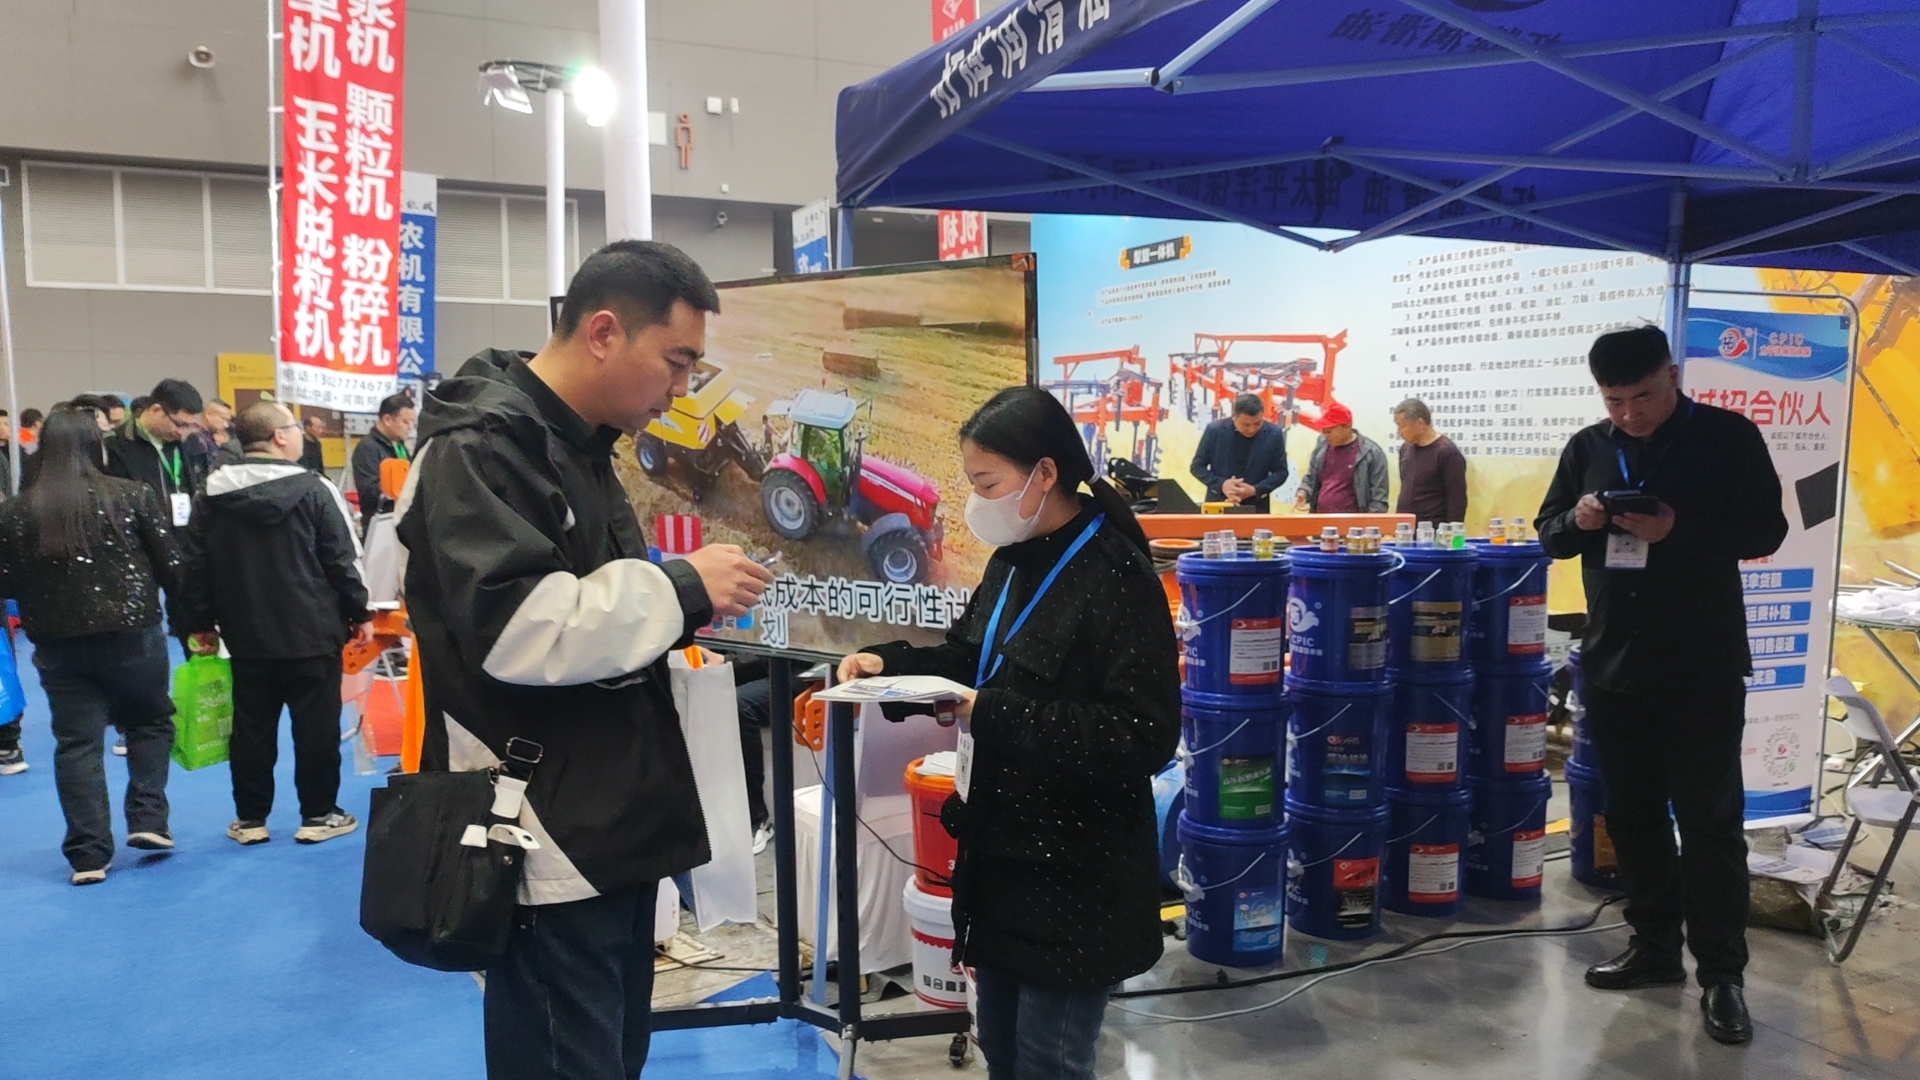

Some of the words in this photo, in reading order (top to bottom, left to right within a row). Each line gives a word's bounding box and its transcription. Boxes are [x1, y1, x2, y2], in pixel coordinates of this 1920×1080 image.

[343, 81, 395, 221] 颗粒机
[292, 94, 340, 366] 玉米脱粒机
[339, 233, 394, 368] 粉碎机
[763, 609, 787, 647] 划
[1291, 634, 1315, 647] CPIC
